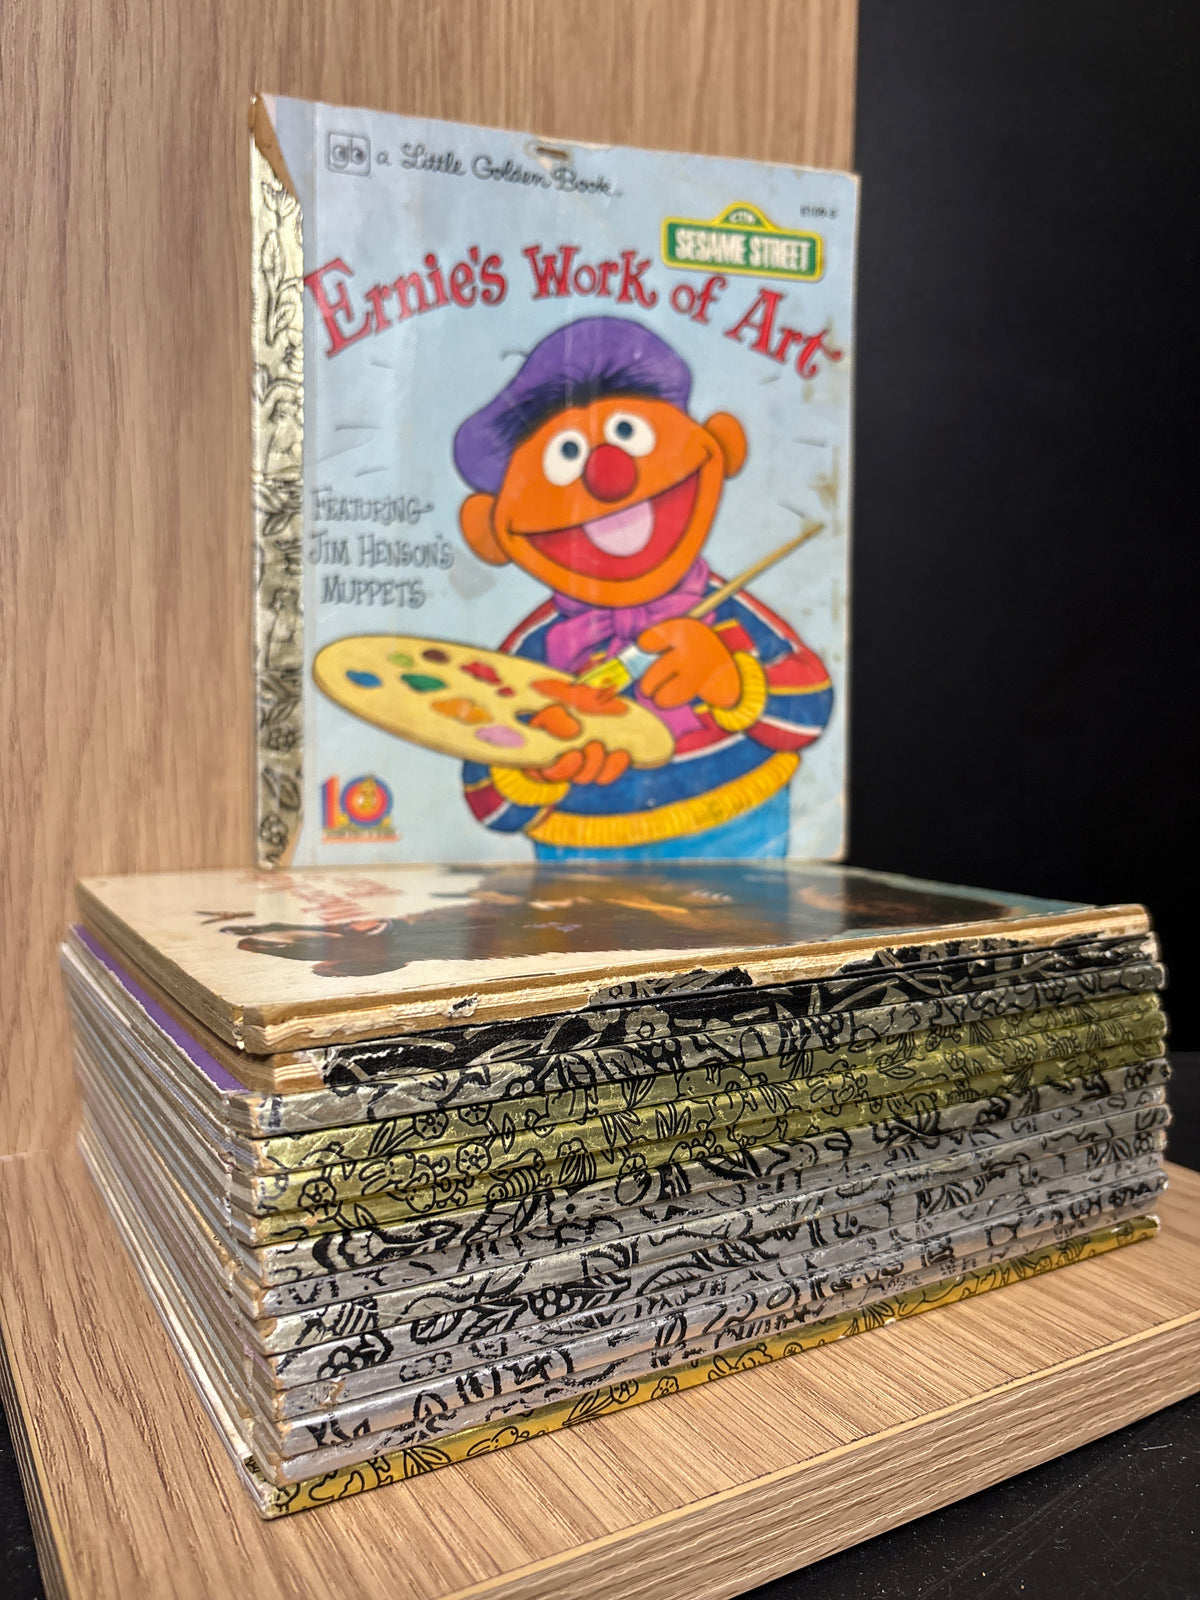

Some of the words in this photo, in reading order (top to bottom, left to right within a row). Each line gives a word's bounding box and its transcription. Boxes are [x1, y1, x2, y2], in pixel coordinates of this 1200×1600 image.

[376, 151, 392, 167] a
[400, 142, 466, 177] Little
[471, 154, 552, 189] Golden
[551, 166, 616, 197] Book
[674, 227, 747, 265] SESAME
[750, 236, 812, 272] STREET
[303, 246, 507, 360] Ernie's
[522, 245, 658, 310] Work
[669, 275, 727, 325] of
[724, 287, 843, 379] Art
[320, 573, 427, 609] MUPPETS
